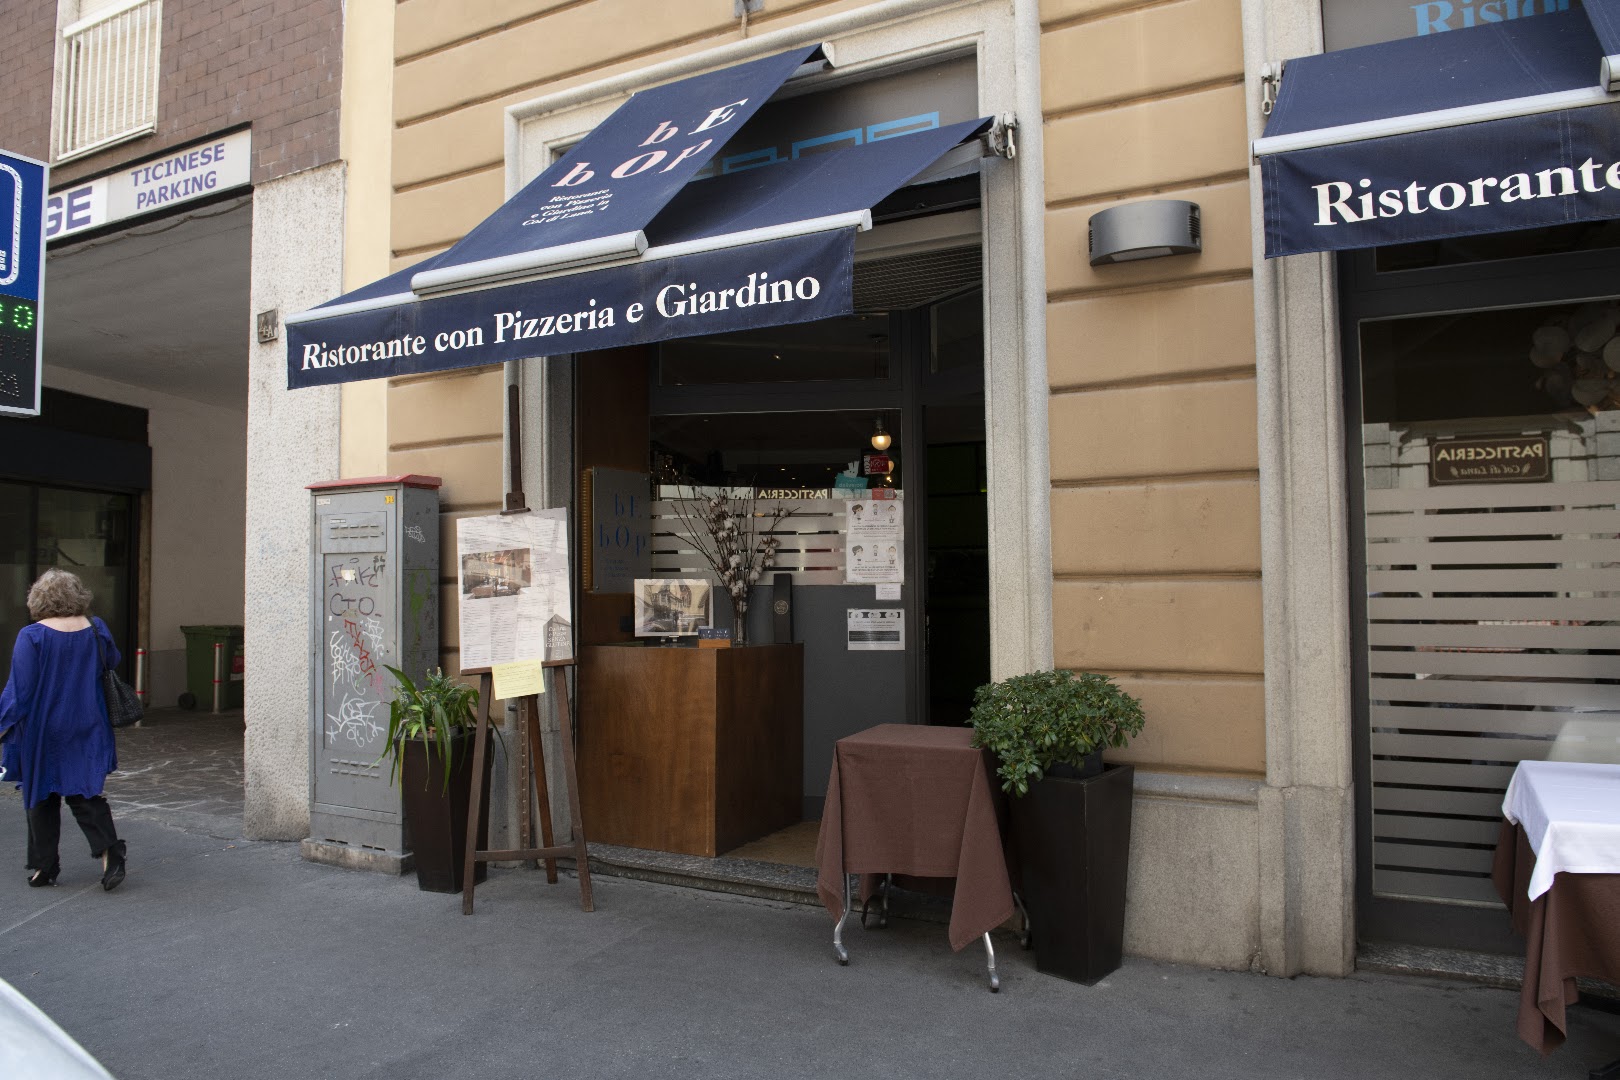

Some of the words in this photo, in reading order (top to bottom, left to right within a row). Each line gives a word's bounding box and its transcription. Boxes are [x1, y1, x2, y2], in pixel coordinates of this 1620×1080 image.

[131, 143, 225, 187] TICINESE
[137, 171, 217, 210] PARKING
[540, 203, 563, 211] con
[564, 193, 613, 208] Pizzeria
[549, 188, 610, 203] Ristorante
[542, 203, 595, 217] Giardino
[300, 334, 427, 371] Ristorante
[434, 326, 485, 353] con
[493, 298, 616, 345] Pizzeria
[626, 301, 645, 324] e
[655, 271, 821, 319] Giardino
